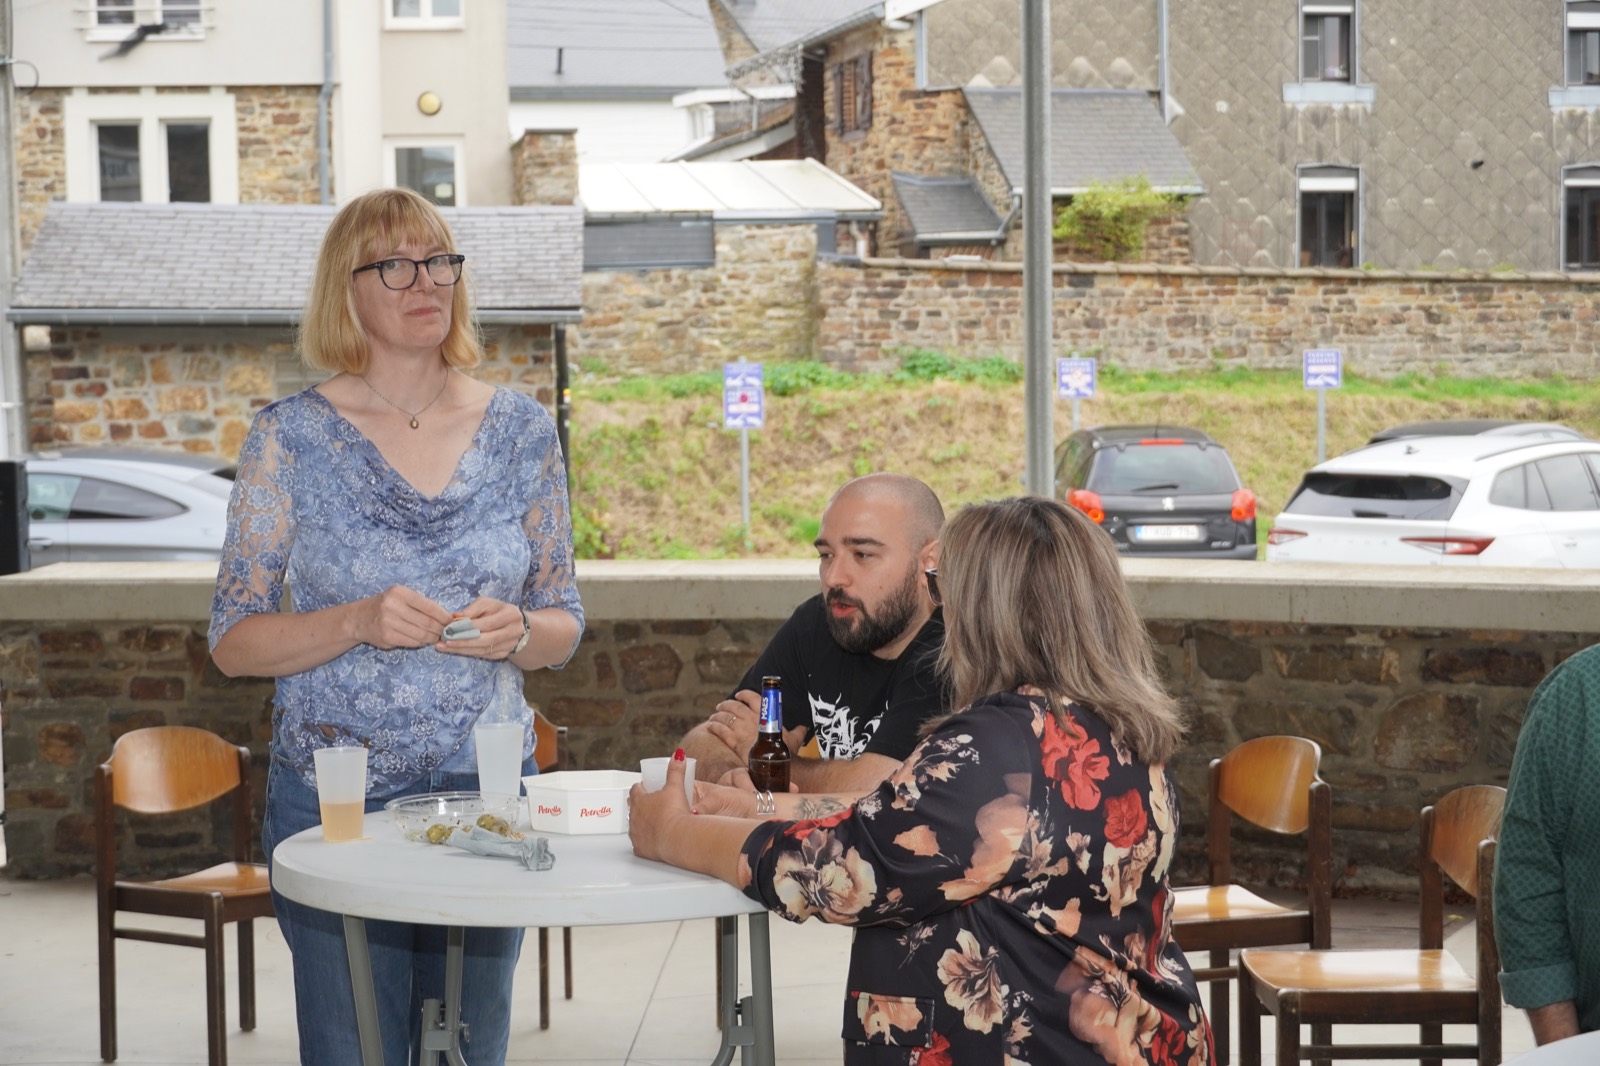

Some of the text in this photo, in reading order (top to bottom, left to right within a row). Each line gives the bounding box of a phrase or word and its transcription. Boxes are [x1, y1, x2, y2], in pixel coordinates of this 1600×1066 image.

[761, 697, 769, 720] MAES
[538, 805, 562, 817] Petrella
[580, 806, 613, 818] Petrella
